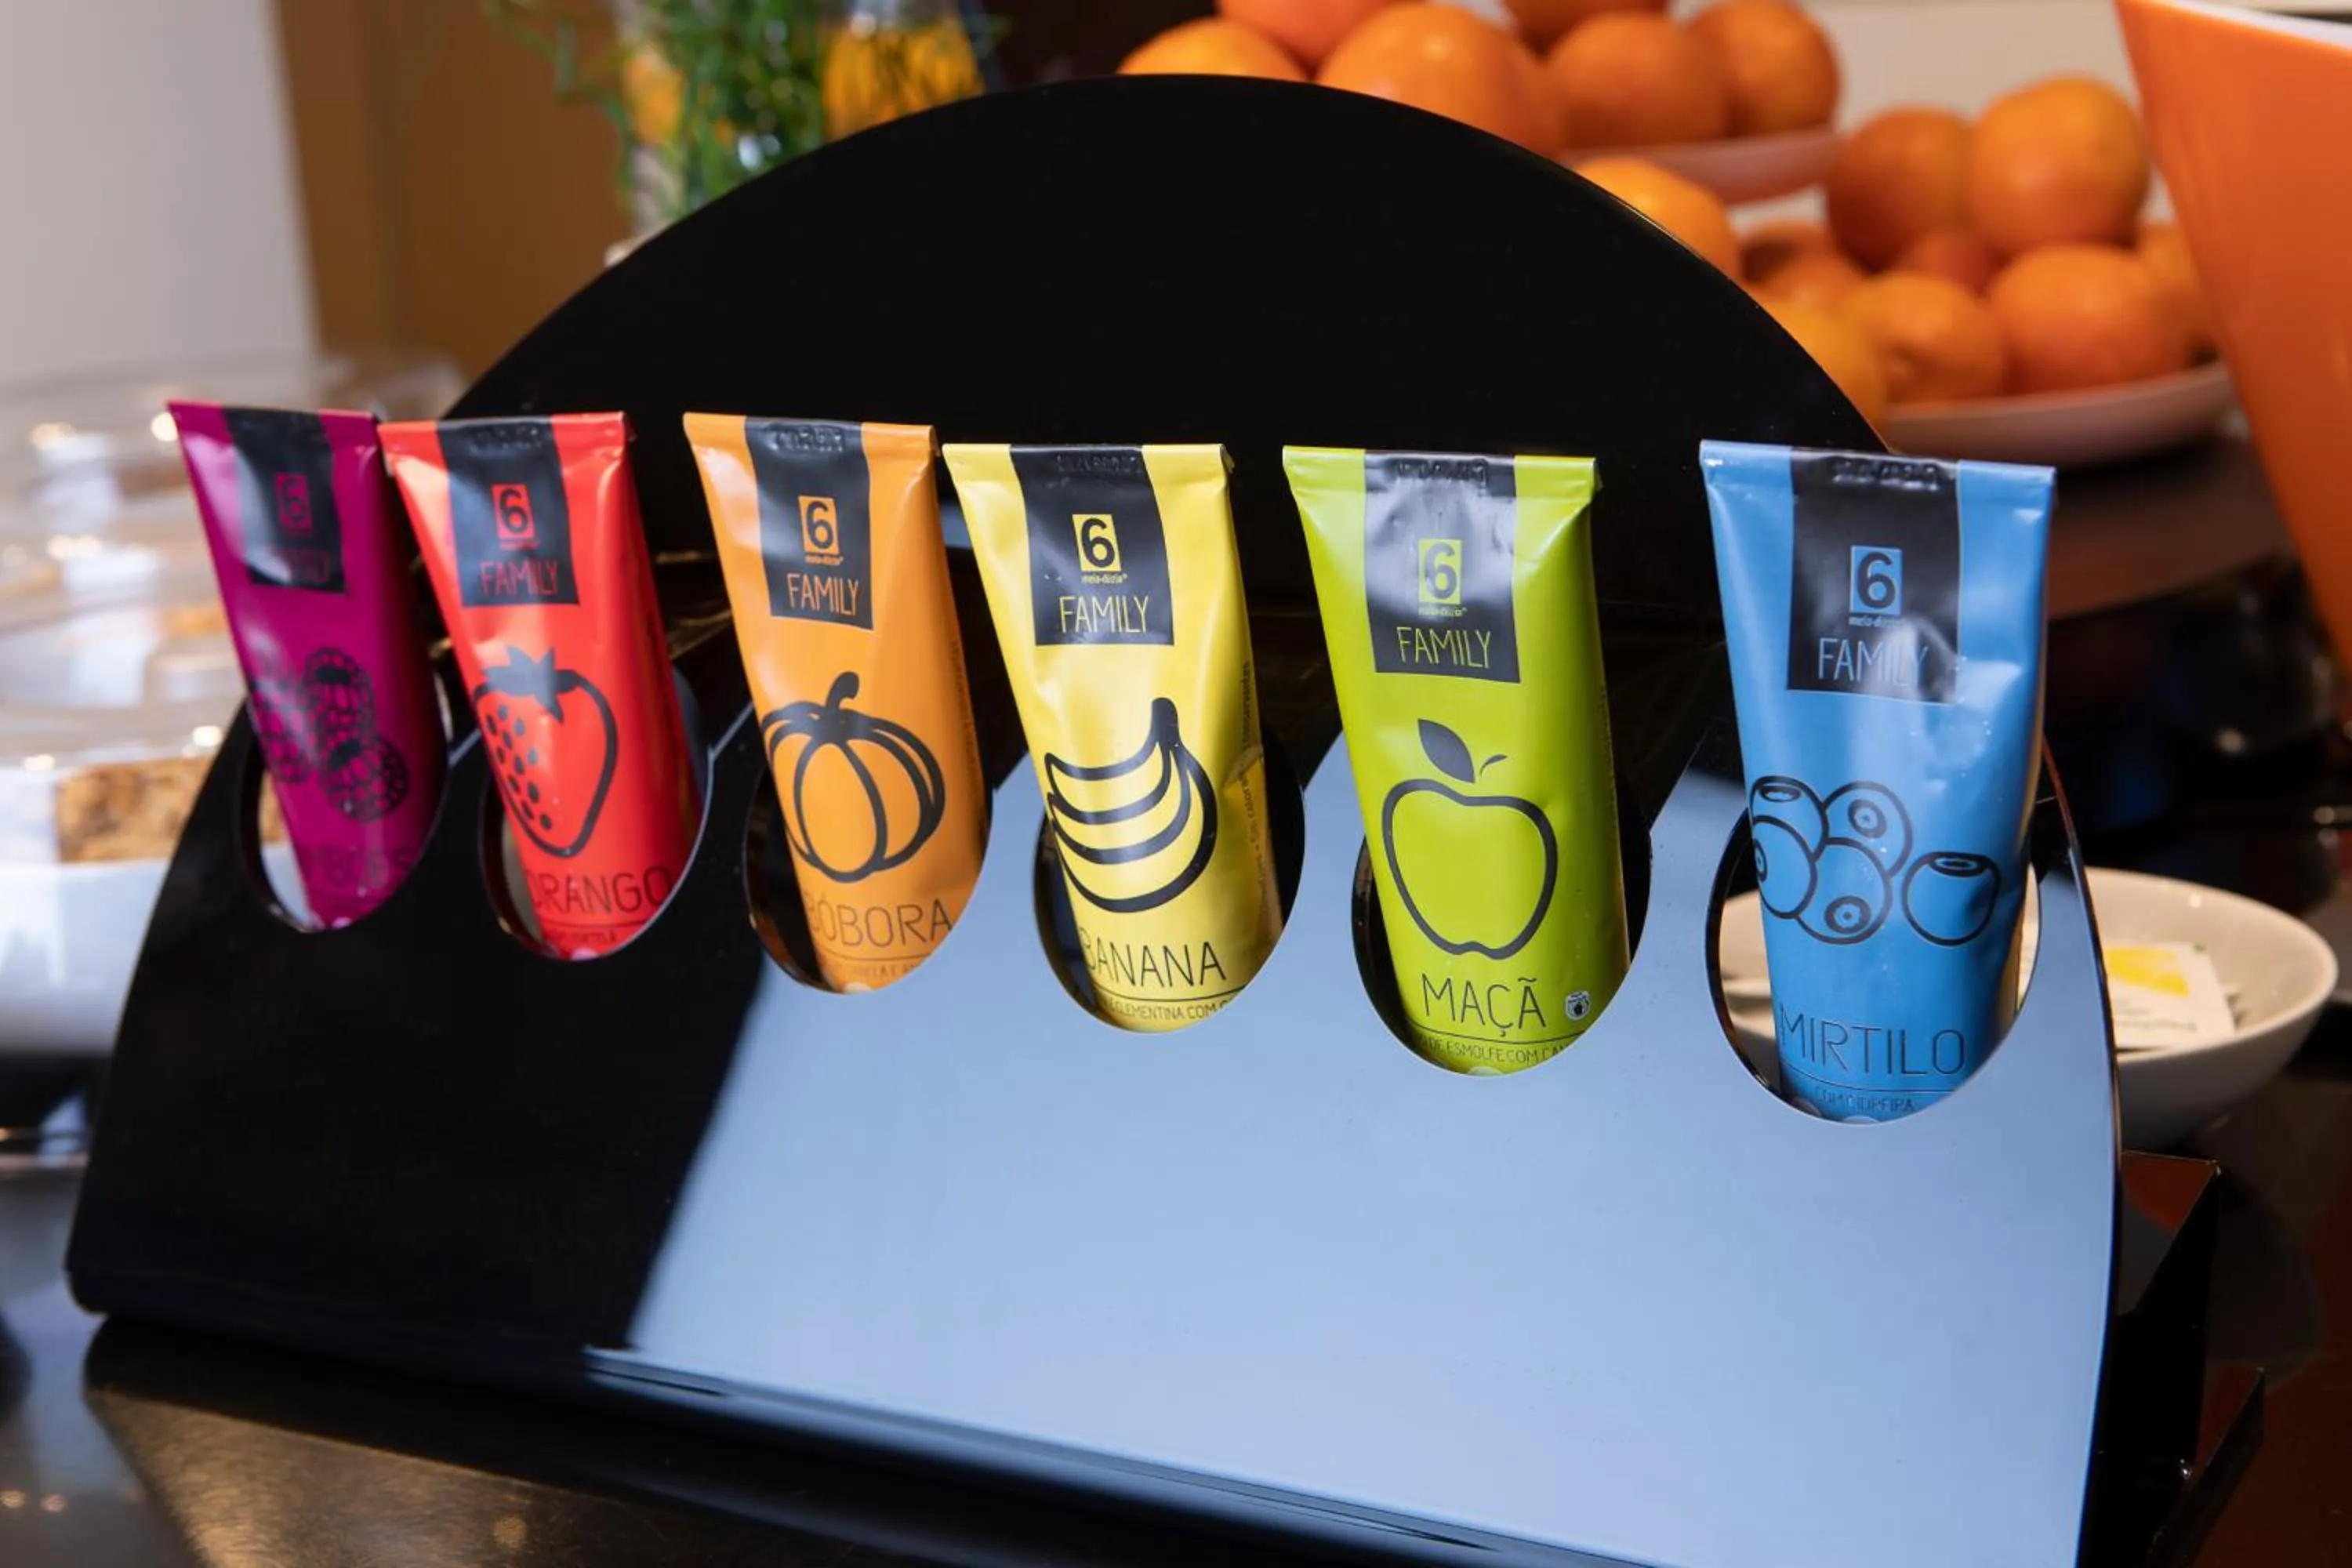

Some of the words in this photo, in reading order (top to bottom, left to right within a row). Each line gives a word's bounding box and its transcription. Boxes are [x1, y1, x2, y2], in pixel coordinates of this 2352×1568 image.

[283, 477, 307, 523] 6
[499, 488, 528, 534] 6
[806, 500, 833, 550] 6
[1081, 517, 1116, 568] 6
[480, 558, 557, 597] FAMILY
[1424, 542, 1457, 600] 6
[1857, 551, 1896, 610] 6
[786, 573, 859, 616] FAMILY
[1059, 595, 1149, 633] FAMILY
[1396, 626, 1491, 669] FAMILY
[1079, 927, 1227, 988] BANANA
[1186, 1003, 1217, 1019] COM
[1421, 973, 1547, 1037] MAÇÃ
[1507, 1047, 1539, 1065] COM
[1780, 1003, 1965, 1075] MIRTILO
